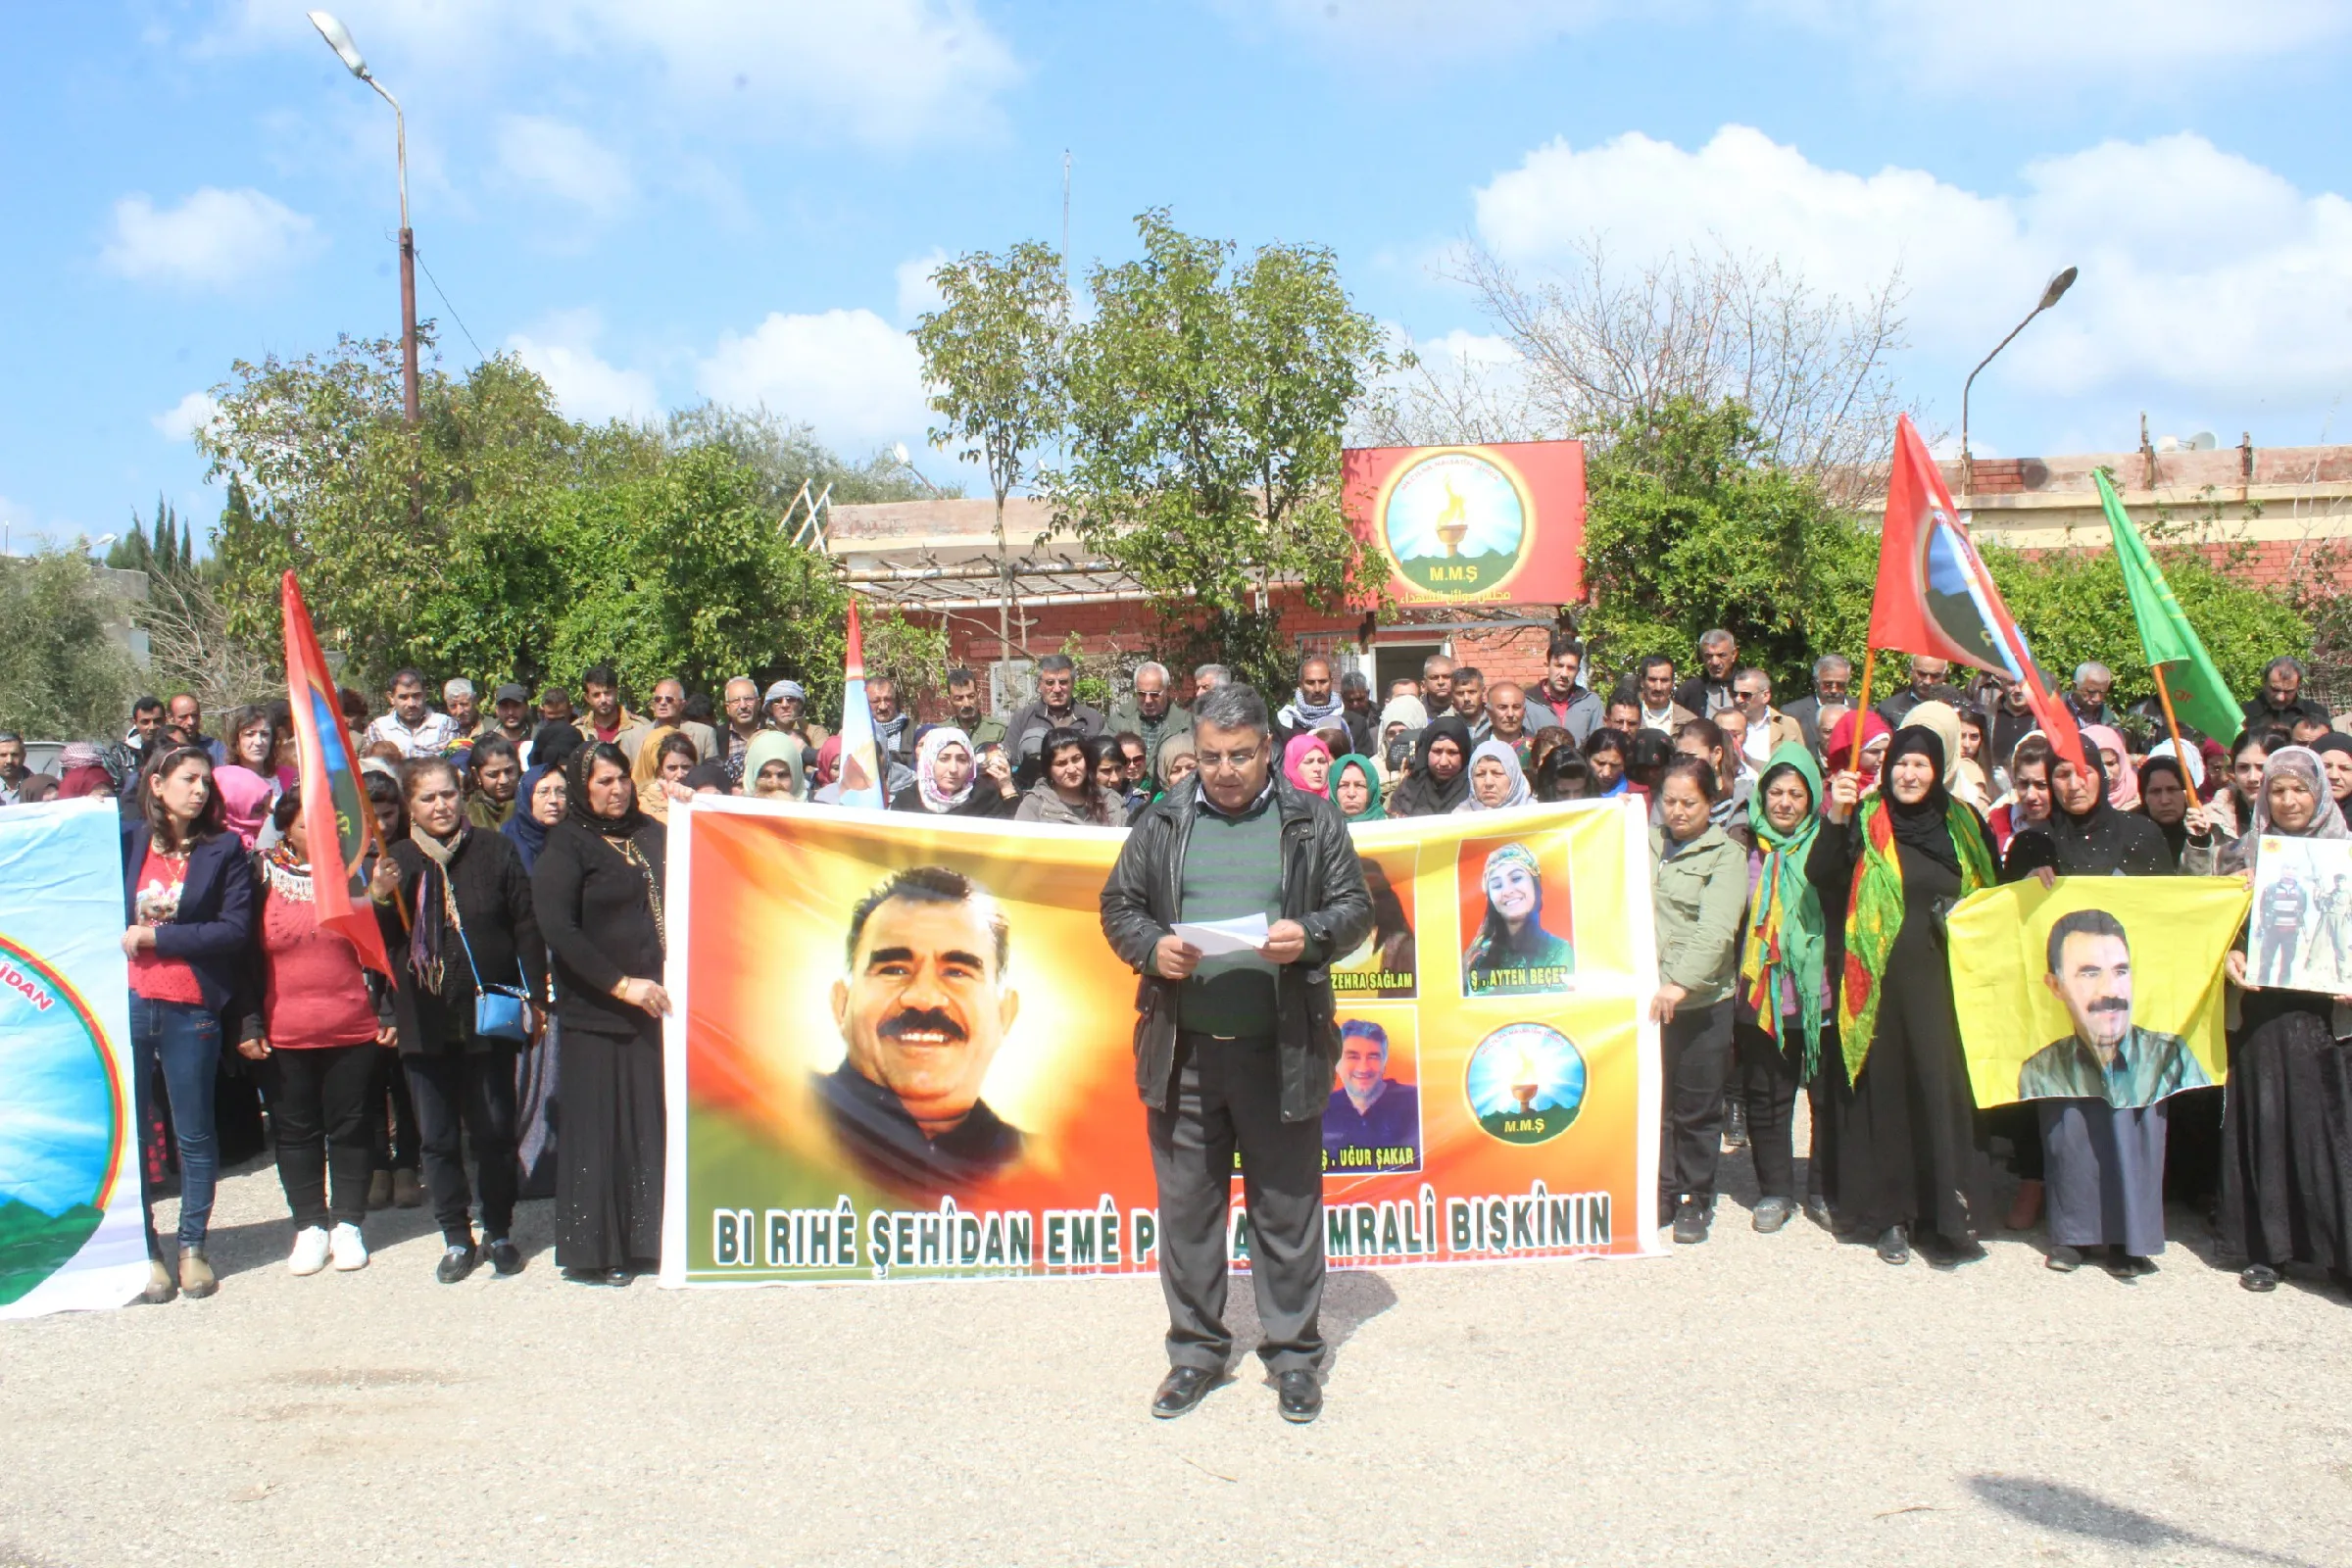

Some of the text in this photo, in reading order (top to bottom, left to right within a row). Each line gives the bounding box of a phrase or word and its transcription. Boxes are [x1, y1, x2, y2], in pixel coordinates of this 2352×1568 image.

[1430, 565, 1478, 583] M.M.Ş
[1478, 589, 1511, 604] مجلس
[1330, 968, 1413, 990] ZEHRA SAĞLAM
[1504, 1118, 1545, 1133] M.M.Ş
[1340, 1145, 1372, 1167] UĞUR
[1376, 1148, 1414, 1170] ŞAKAR
[1326, 1185, 1437, 1256] MRALÎ
[1451, 1181, 1612, 1255] BIŞKÎNIN
[716, 1212, 753, 1265] BI
[767, 1196, 856, 1265] RIHÊ
[868, 1197, 1032, 1277] ŞEHÎDAN
[1047, 1195, 1119, 1265] EMÊ
